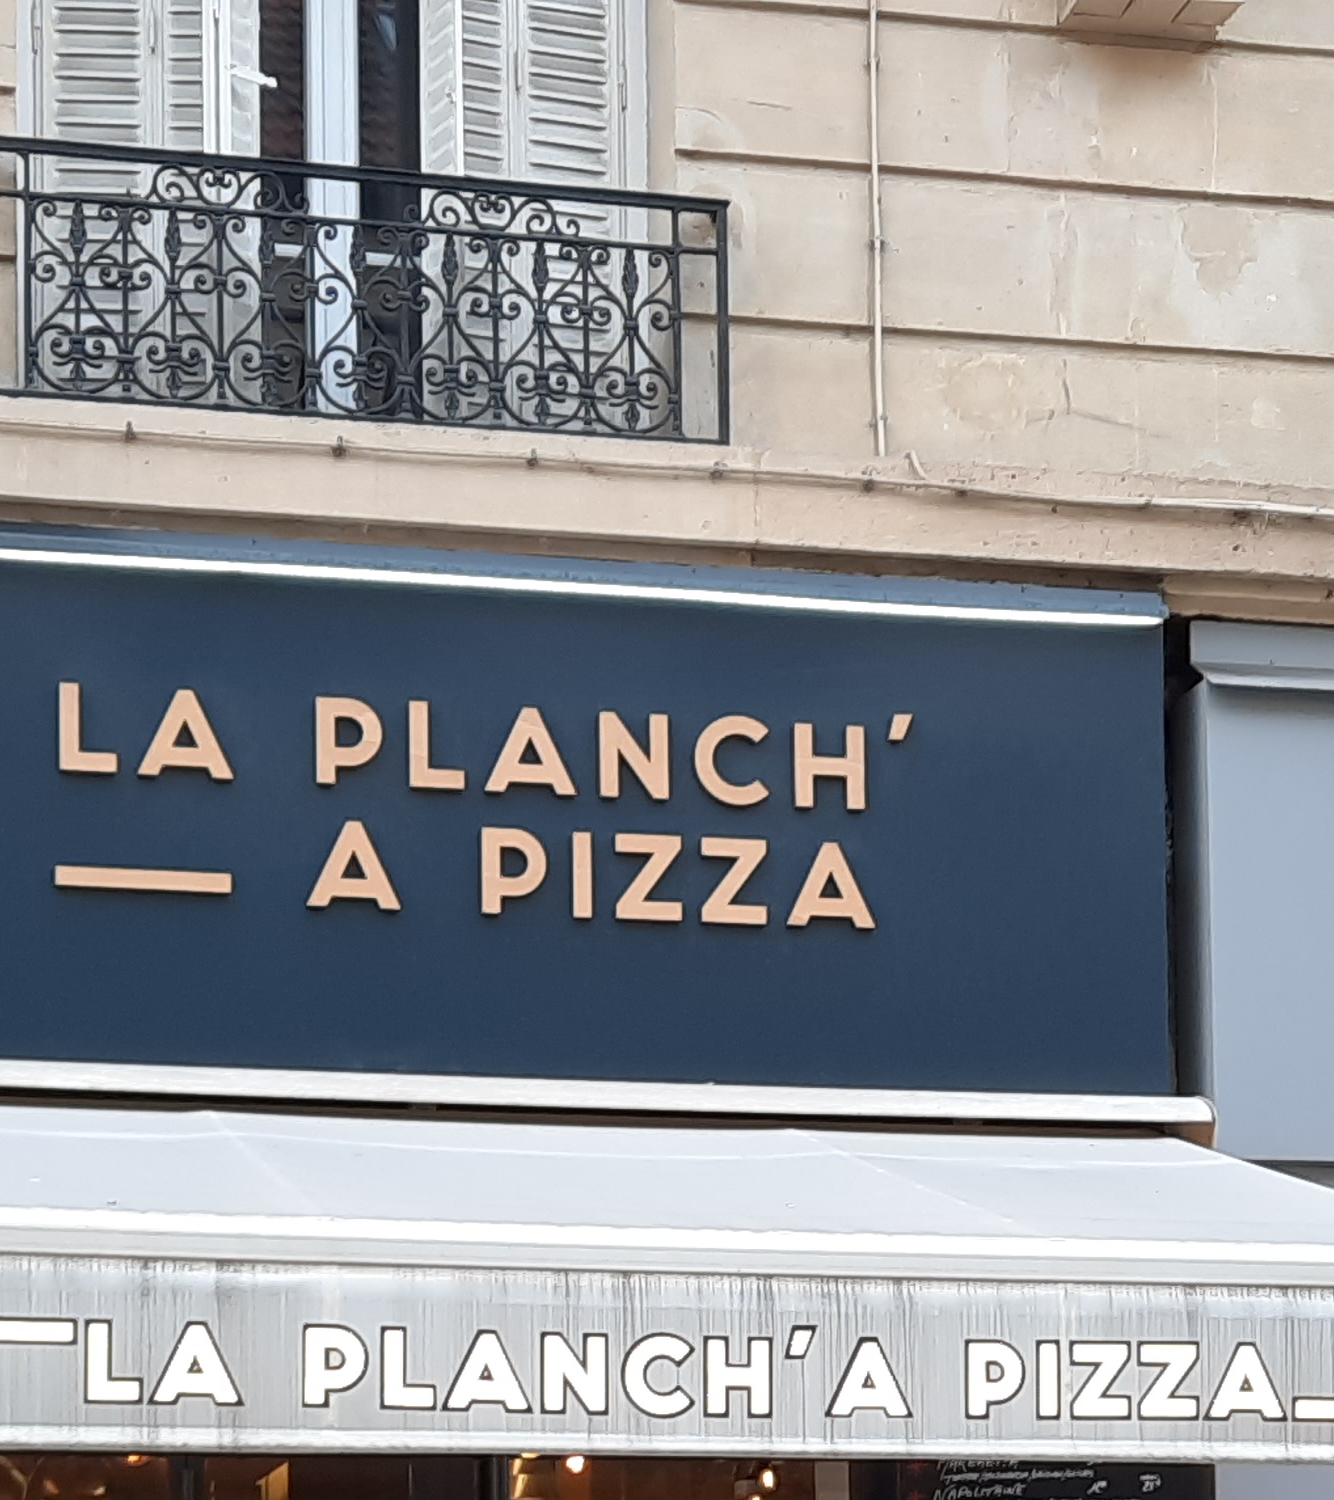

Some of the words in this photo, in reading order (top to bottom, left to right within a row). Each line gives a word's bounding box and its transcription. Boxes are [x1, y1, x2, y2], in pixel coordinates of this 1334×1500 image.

[58, 681, 234, 781] LA
[314, 694, 913, 811] PLANCH'
[306, 819, 402, 912] A
[479, 826, 877, 930] PIZZA
[84, 1319, 245, 1407] LA
[965, 1338, 1288, 1423] PIZZA
